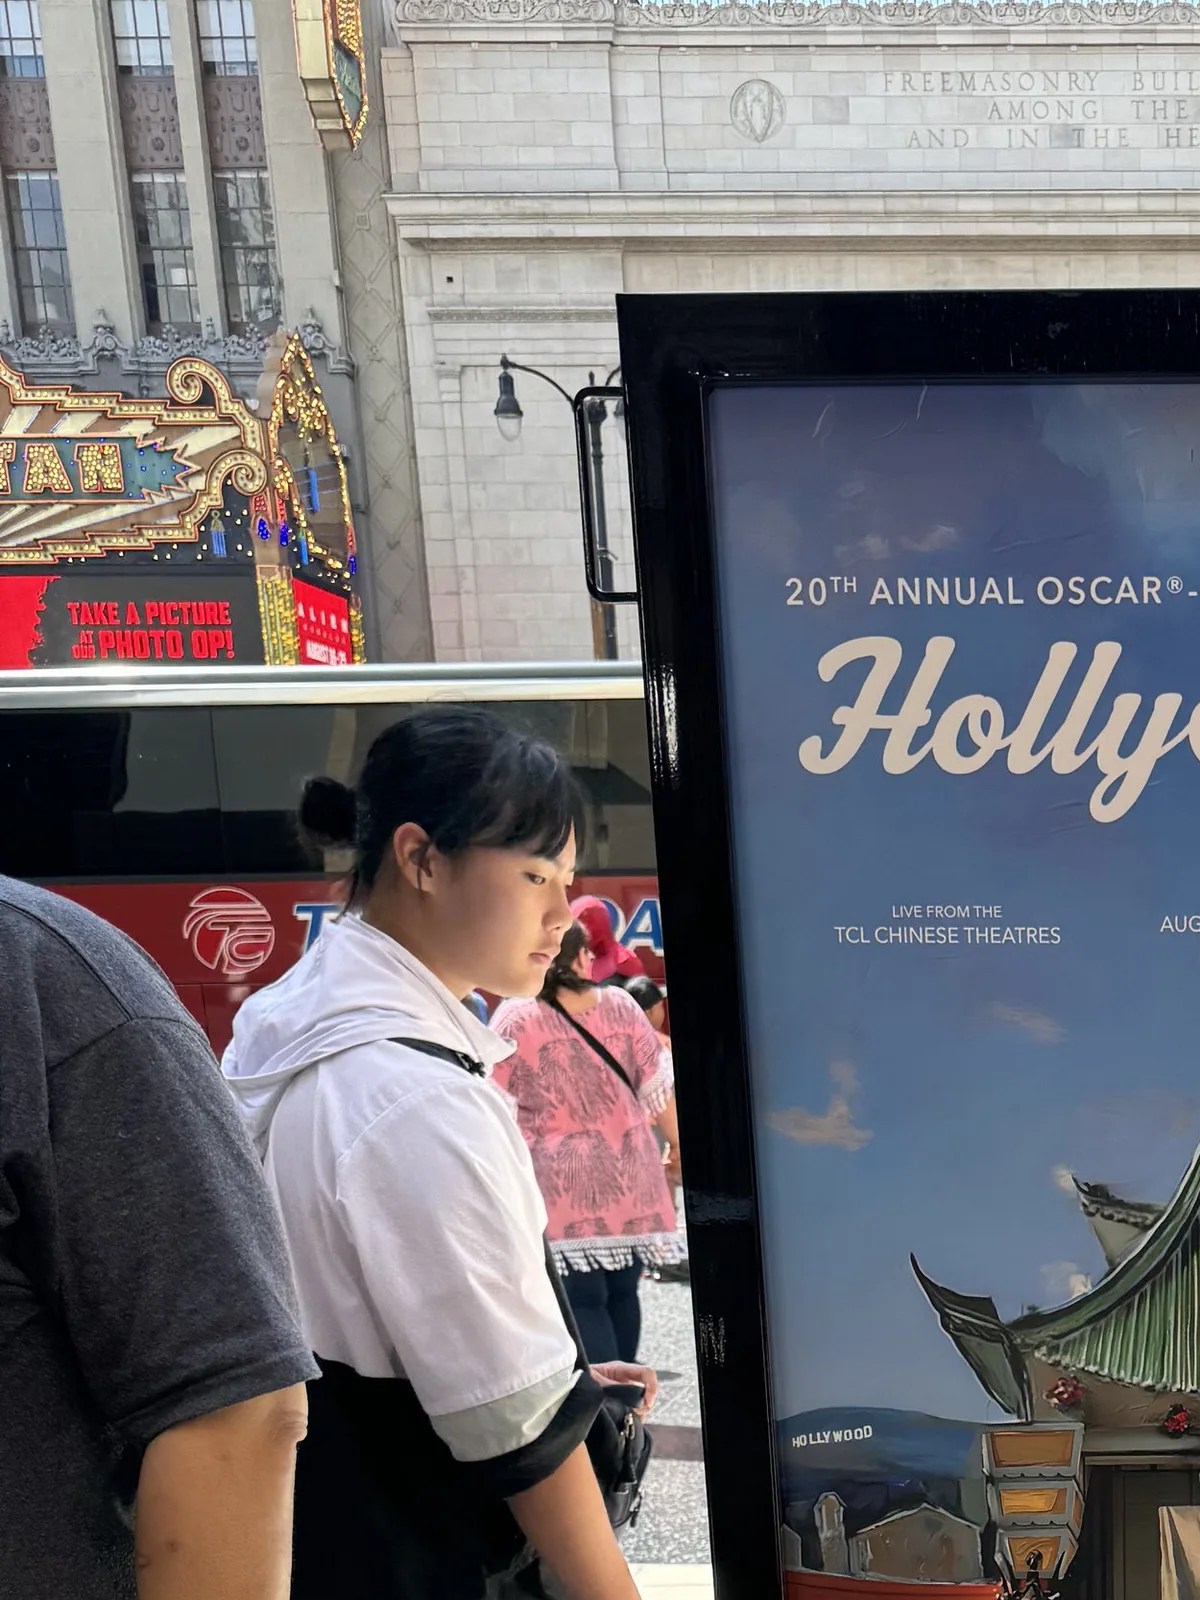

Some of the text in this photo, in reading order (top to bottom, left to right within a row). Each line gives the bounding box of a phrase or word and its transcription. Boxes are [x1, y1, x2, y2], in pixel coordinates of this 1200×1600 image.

[883, 71, 1099, 92] FREEMASONRY
[987, 99, 1098, 120] AMONG
[1131, 99, 1188, 120] THE
[907, 128, 970, 148] AND
[1007, 128, 1039, 148] IN
[1071, 128, 1130, 148] THE
[785, 576, 857, 606] 20TH
[870, 576, 1024, 606] ANNUAL
[67, 602, 232, 626] TAKE A PICTURE
[79, 630, 94, 644] AT
[98, 629, 235, 660] PHOTO OP!
[71, 644, 96, 660] OUR
[892, 905, 1003, 919] LIVE FROM THE
[834, 926, 1061, 945] TCL CHINESE THEATRES
[791, 1424, 874, 1448] HOLLYWOOD
